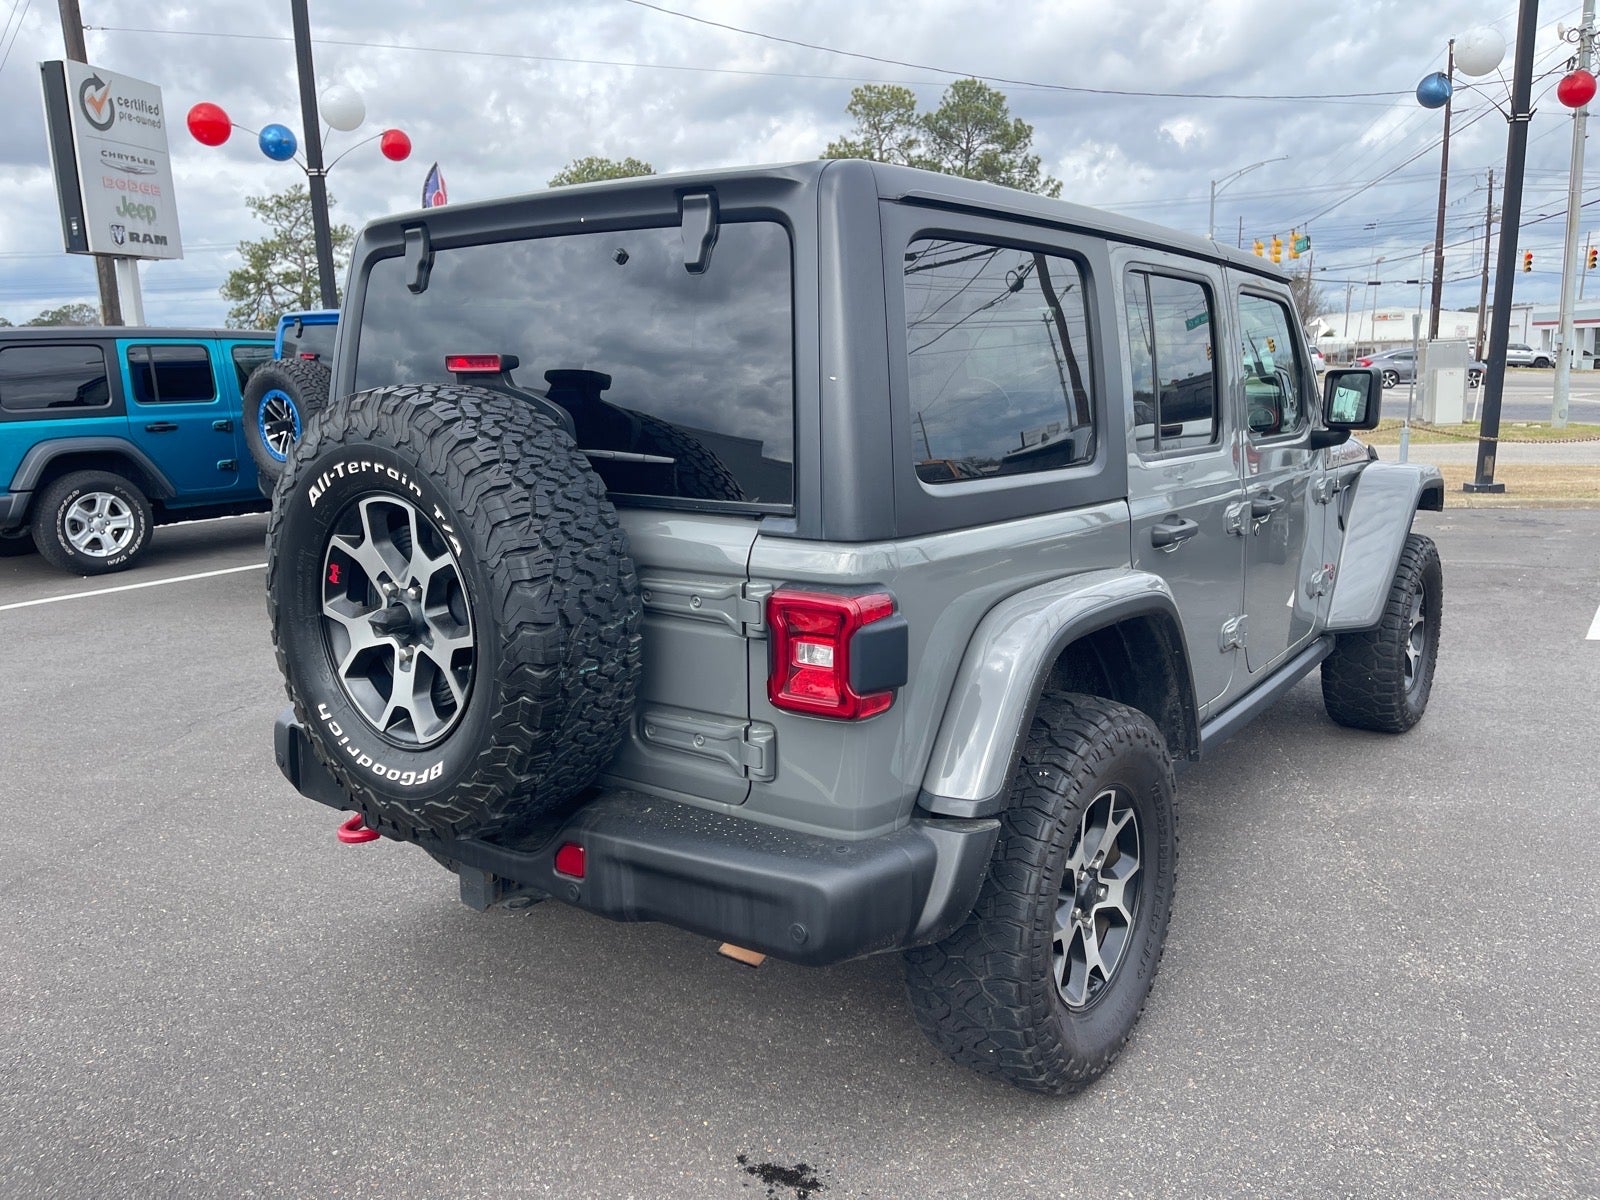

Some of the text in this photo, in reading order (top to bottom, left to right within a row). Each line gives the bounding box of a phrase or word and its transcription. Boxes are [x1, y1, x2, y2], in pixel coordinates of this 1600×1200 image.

[117, 96, 160, 116] certified
[119, 111, 162, 129] pre-owned
[101, 150, 156, 166] CHRYSLER
[102, 176, 161, 196] DODGE
[116, 195, 157, 226] Jeep
[128, 231, 168, 246] RAM
[308, 461, 462, 557] All-Terrain T/A
[317, 703, 444, 786] BFGoodrich
